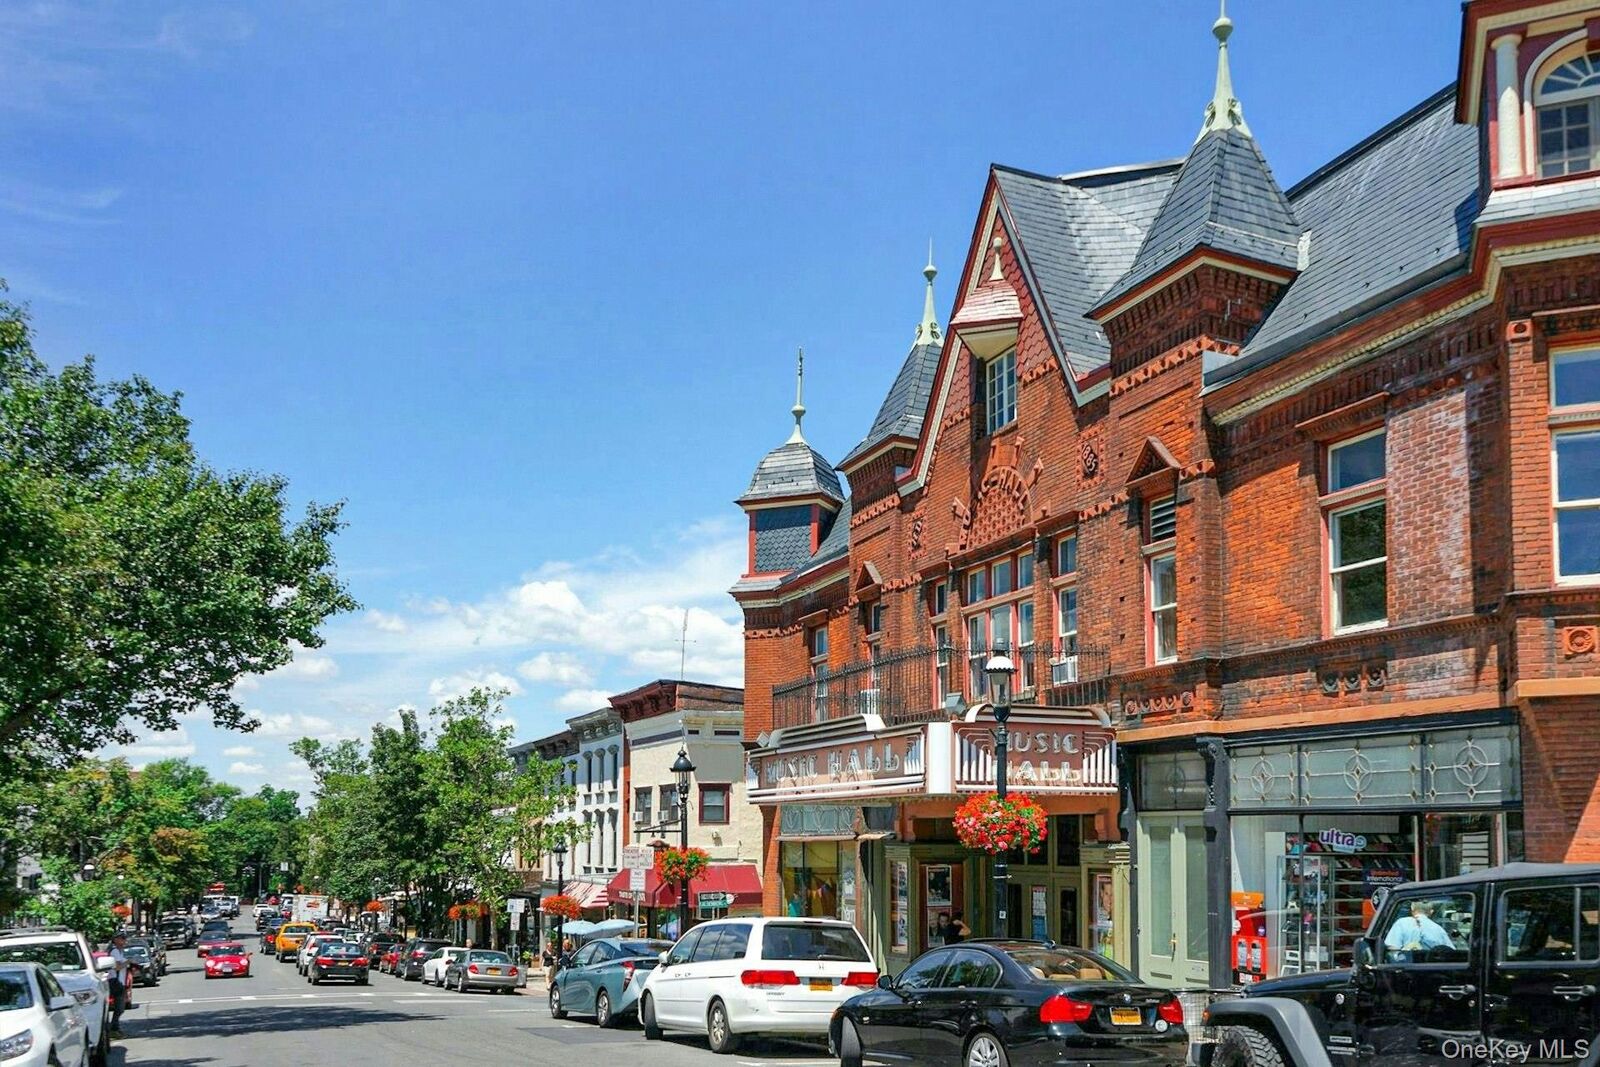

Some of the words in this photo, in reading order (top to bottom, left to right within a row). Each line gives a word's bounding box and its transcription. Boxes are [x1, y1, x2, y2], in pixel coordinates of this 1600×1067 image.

[766, 754, 818, 784] MUSIC
[828, 743, 900, 776] HALL
[1320, 829, 1356, 847] ultra
